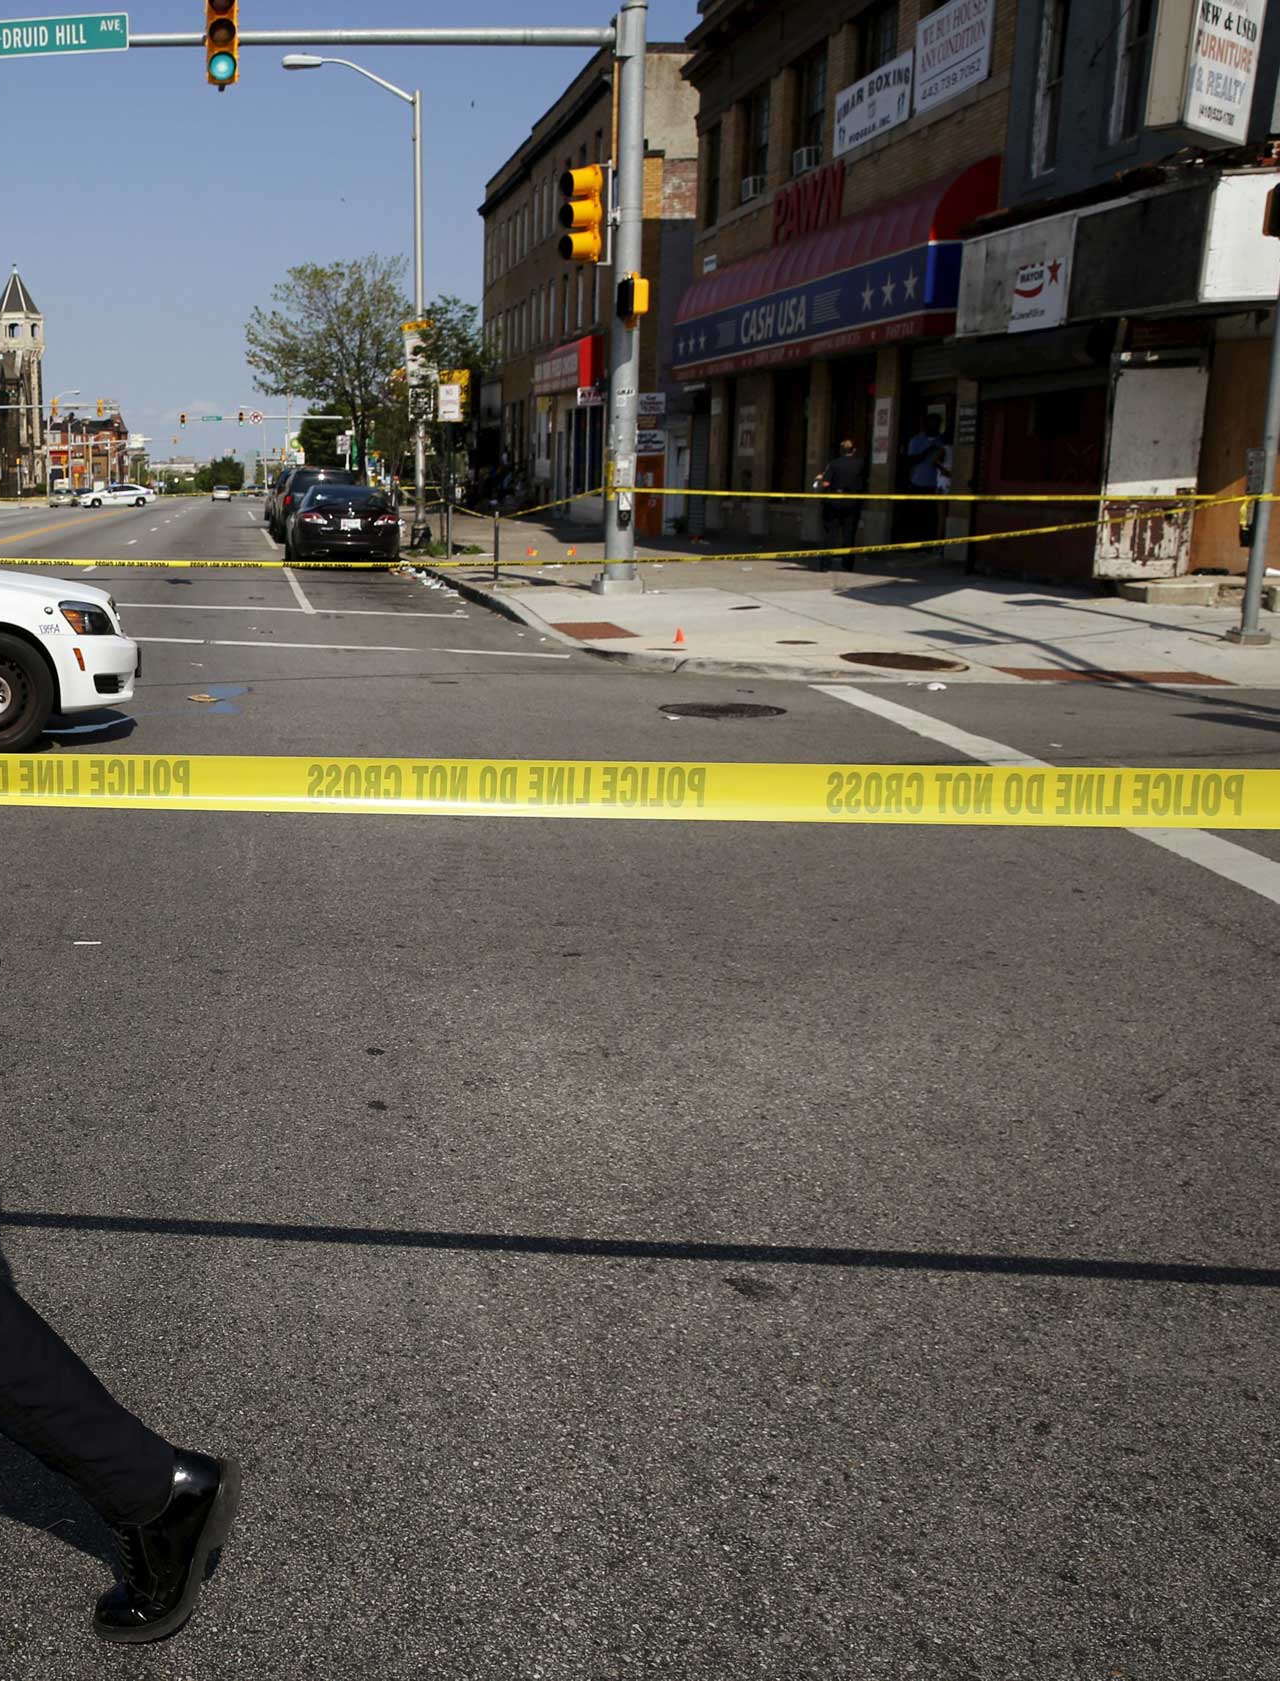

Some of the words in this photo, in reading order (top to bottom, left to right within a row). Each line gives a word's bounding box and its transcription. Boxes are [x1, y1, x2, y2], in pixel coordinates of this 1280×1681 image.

[2, 25, 49, 50] DRUID
[56, 23, 87, 46] HILL
[99, 18, 121, 31] AVE
[1224, 12, 1233, 31] &
[1236, 15, 1258, 43] USED
[1195, 29, 1254, 74] FURNITURE
[868, 67, 910, 97] BOXING
[1206, 70, 1246, 105] REALTY
[773, 160, 846, 246] PAWN
[740, 303, 773, 344] CASH
[778, 295, 807, 337] USA
